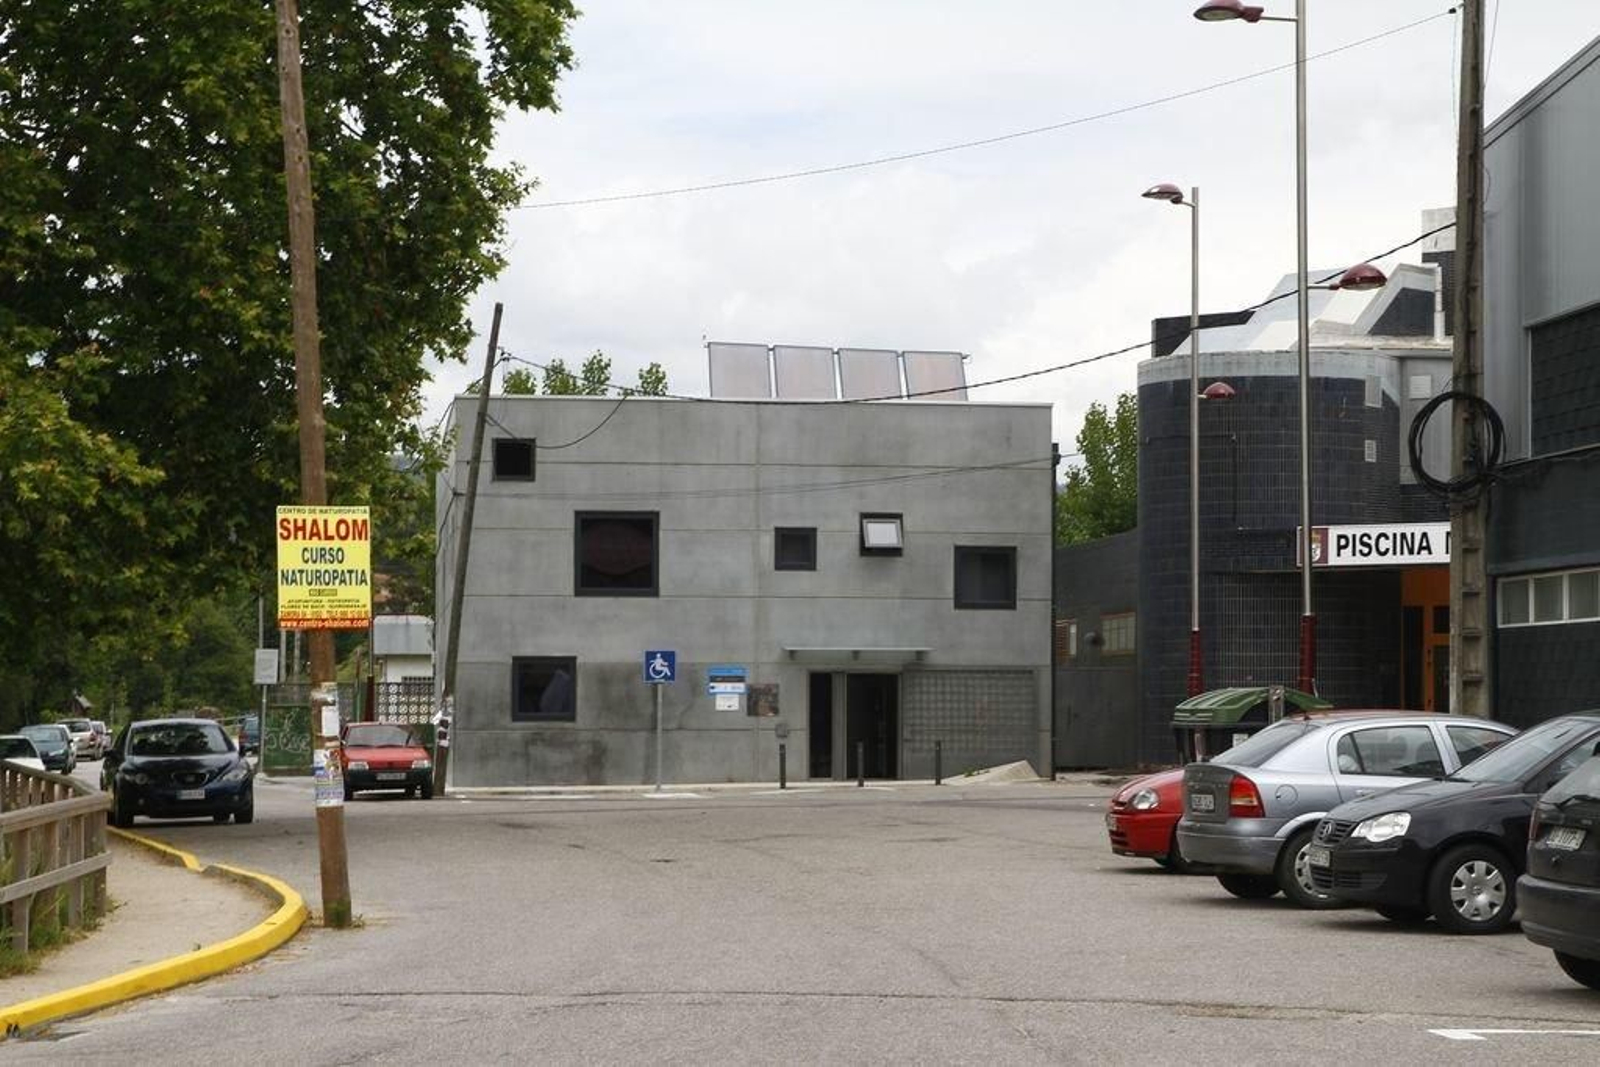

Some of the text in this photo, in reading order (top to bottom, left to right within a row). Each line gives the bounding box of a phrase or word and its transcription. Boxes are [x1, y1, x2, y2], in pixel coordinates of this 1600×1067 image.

[279, 518, 368, 541] SHALOM
[1336, 531, 1432, 558] PISCINA
[302, 546, 345, 564] CURSO
[281, 569, 368, 586] NATUROPATIA
